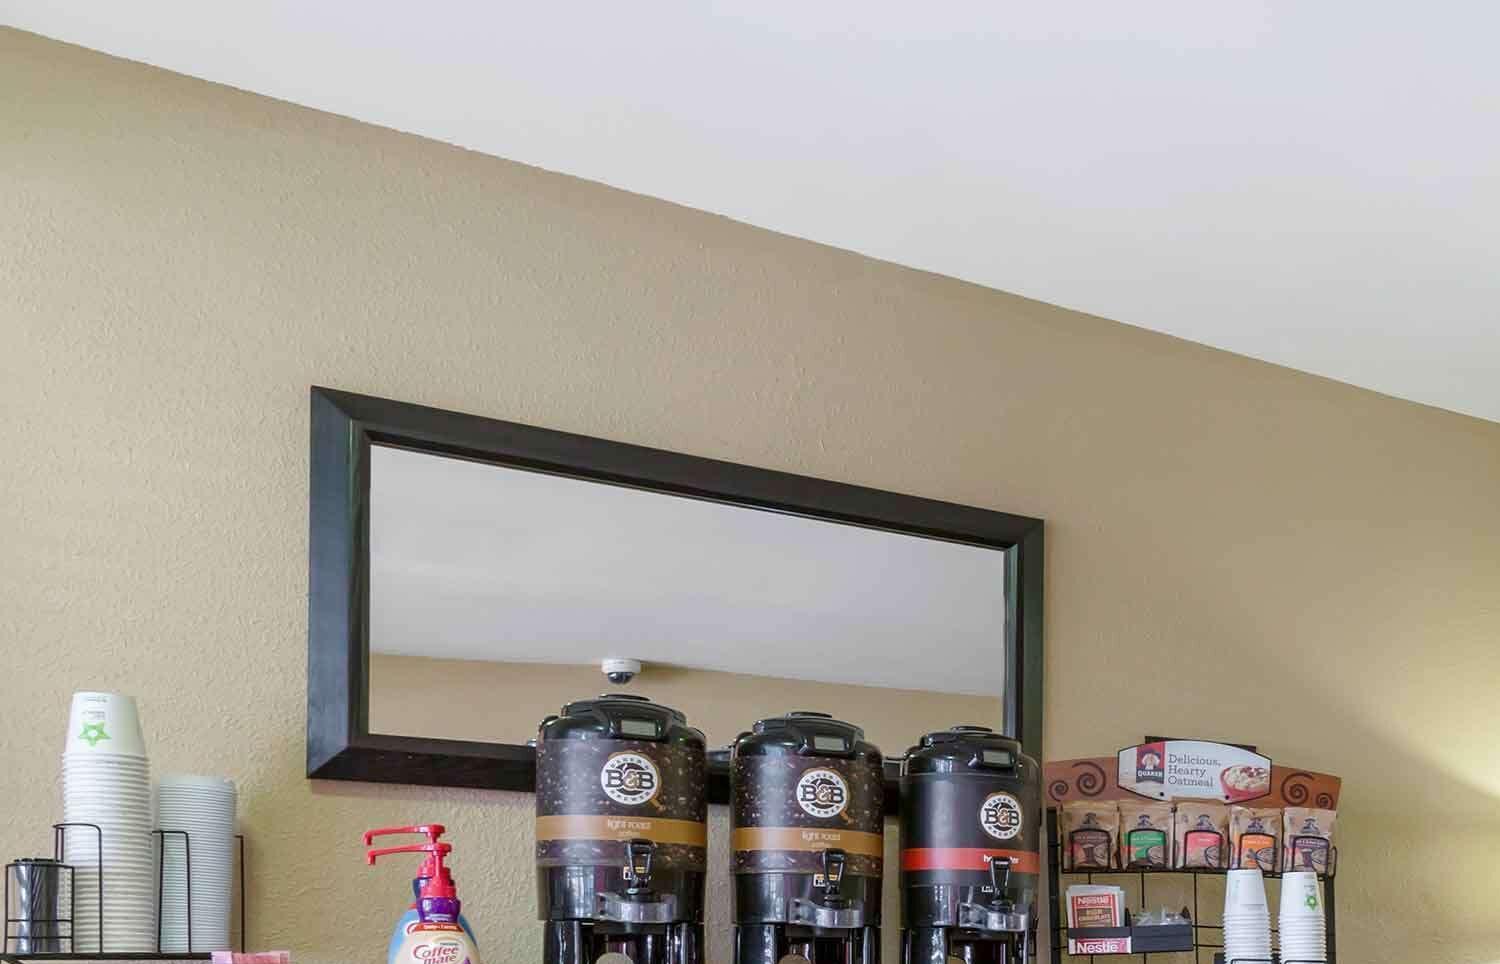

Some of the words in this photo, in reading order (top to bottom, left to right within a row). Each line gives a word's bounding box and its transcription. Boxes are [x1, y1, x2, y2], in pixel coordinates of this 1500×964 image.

[1168, 754, 1222, 767] Delicious,
[1168, 765, 1207, 778] Hearty
[1168, 775, 1214, 788] Oatmeal
[413, 943, 460, 960] Coffee
